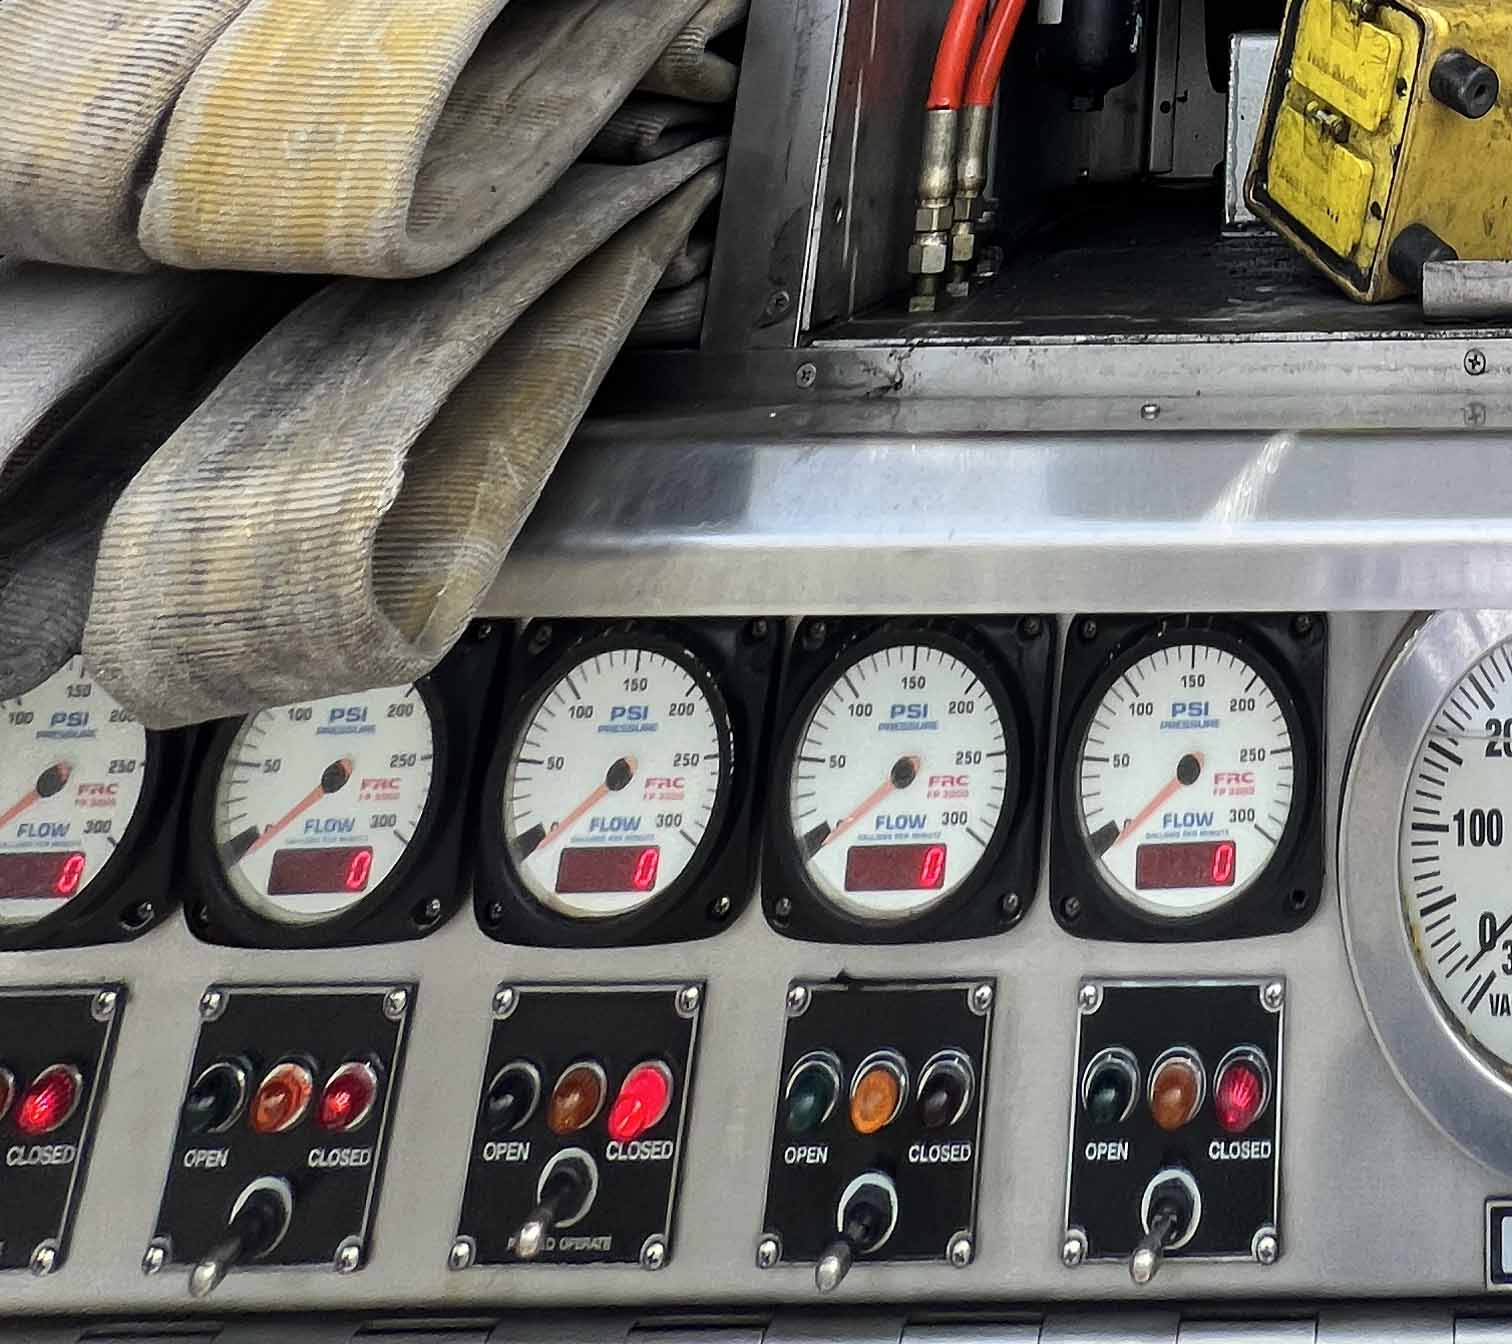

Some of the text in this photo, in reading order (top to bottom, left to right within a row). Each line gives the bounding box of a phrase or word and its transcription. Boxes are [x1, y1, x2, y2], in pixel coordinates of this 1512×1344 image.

[623, 678, 648, 692] 150
[901, 676, 926, 690] 150
[1181, 674, 1205, 688] 150
[67, 684, 91, 697] 150
[387, 704, 414, 717] 200
[568, 705, 593, 719] 100
[669, 703, 695, 717] 200
[848, 703, 873, 717] 100
[890, 703, 929, 719] PSI
[948, 701, 974, 715] 200
[1129, 703, 1154, 717] 100
[1171, 701, 1210, 717] PSI
[1230, 698, 1255, 712] 200
[51, 712, 89, 726] PSI
[288, 708, 312, 721] 100
[329, 707, 368, 722] PSI
[610, 705, 649, 721] PSI
[1160, 719, 1220, 730] PRESSURE
[390, 753, 416, 768] 250
[673, 753, 700, 767] 250
[829, 755, 846, 768] 50
[955, 751, 982, 765] 250
[1113, 753, 1130, 767] 50
[1240, 748, 1266, 762] 250
[264, 759, 281, 773] 50
[547, 756, 565, 770] 50
[1214, 772, 1255, 785] FRC
[656, 814, 682, 828] 300
[876, 814, 927, 830] FLOW
[942, 812, 968, 826] 300
[1163, 812, 1214, 828] FLOW
[1229, 808, 1255, 823] 300
[17, 823, 70, 838] FLOW
[84, 820, 112, 834] 300
[304, 819, 356, 834] FLOW
[590, 816, 641, 832] FLOW
[1452, 808, 1504, 847] 100
[346, 851, 371, 888] 0
[633, 848, 658, 887] 0
[921, 846, 944, 887] 0
[1212, 844, 1233, 883] 0
[56, 854, 84, 893] 0
[1478, 912, 1497, 952] 0
[6, 1144, 77, 1166] CLOSED
[307, 1148, 371, 1167] CLOSED
[483, 1142, 530, 1161] OPEN
[606, 1140, 674, 1160] CLOSED
[784, 1145, 828, 1163] OPEN
[908, 1144, 971, 1162] CLOSED
[1085, 1142, 1129, 1160] OPEN
[1208, 1141, 1271, 1160] CLOSED
[183, 1149, 228, 1169] OPEN
